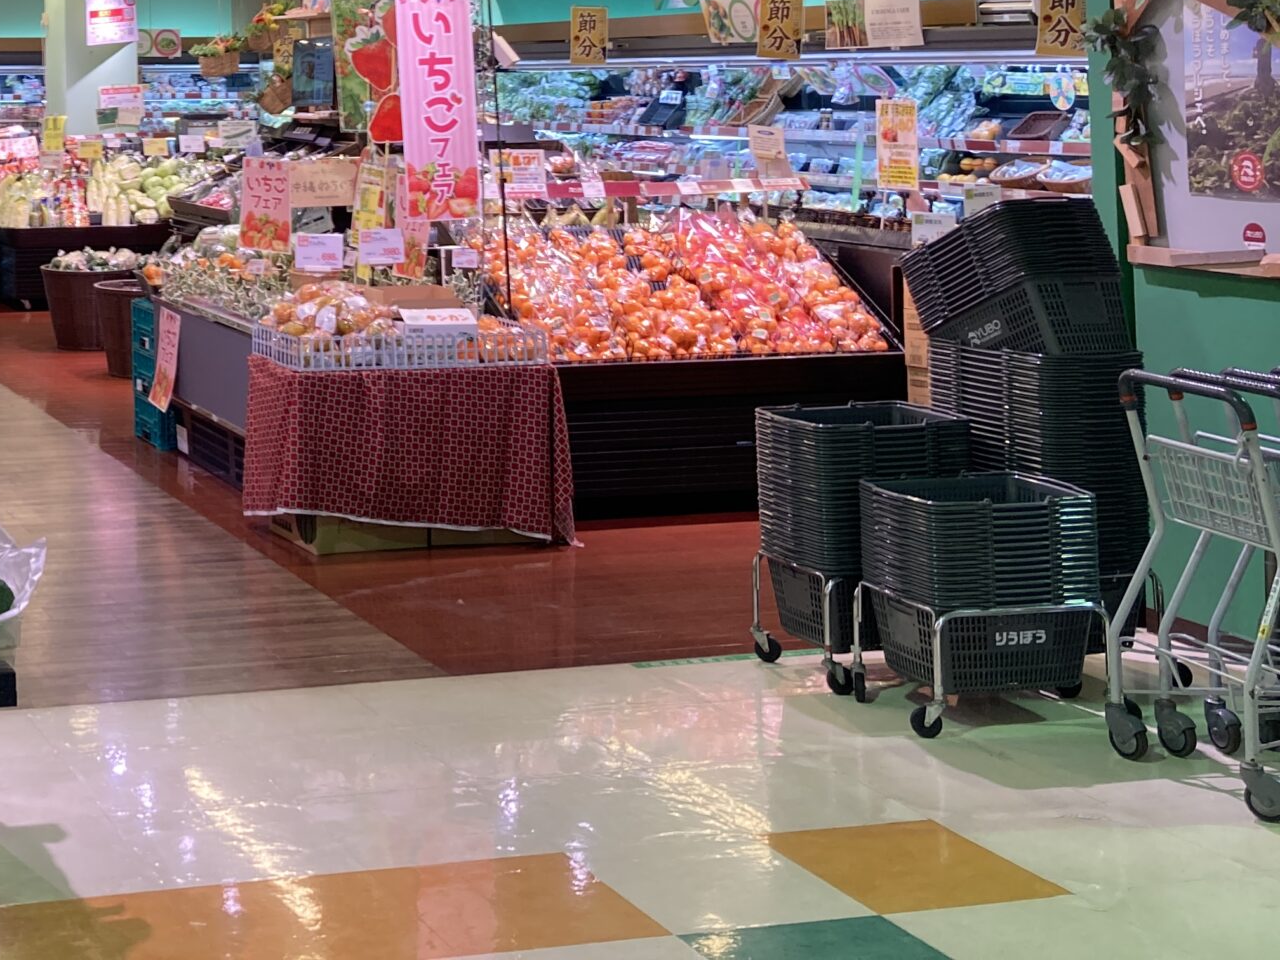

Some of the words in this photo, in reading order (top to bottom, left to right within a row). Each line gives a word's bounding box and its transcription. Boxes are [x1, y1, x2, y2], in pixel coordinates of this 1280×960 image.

[577, 12, 597, 58] 節分
[411, 11, 463, 204] いちごフェア
[246, 174, 288, 193] いちご
[250, 194, 283, 210] フェア
[995, 629, 1047, 646] りうぼう
